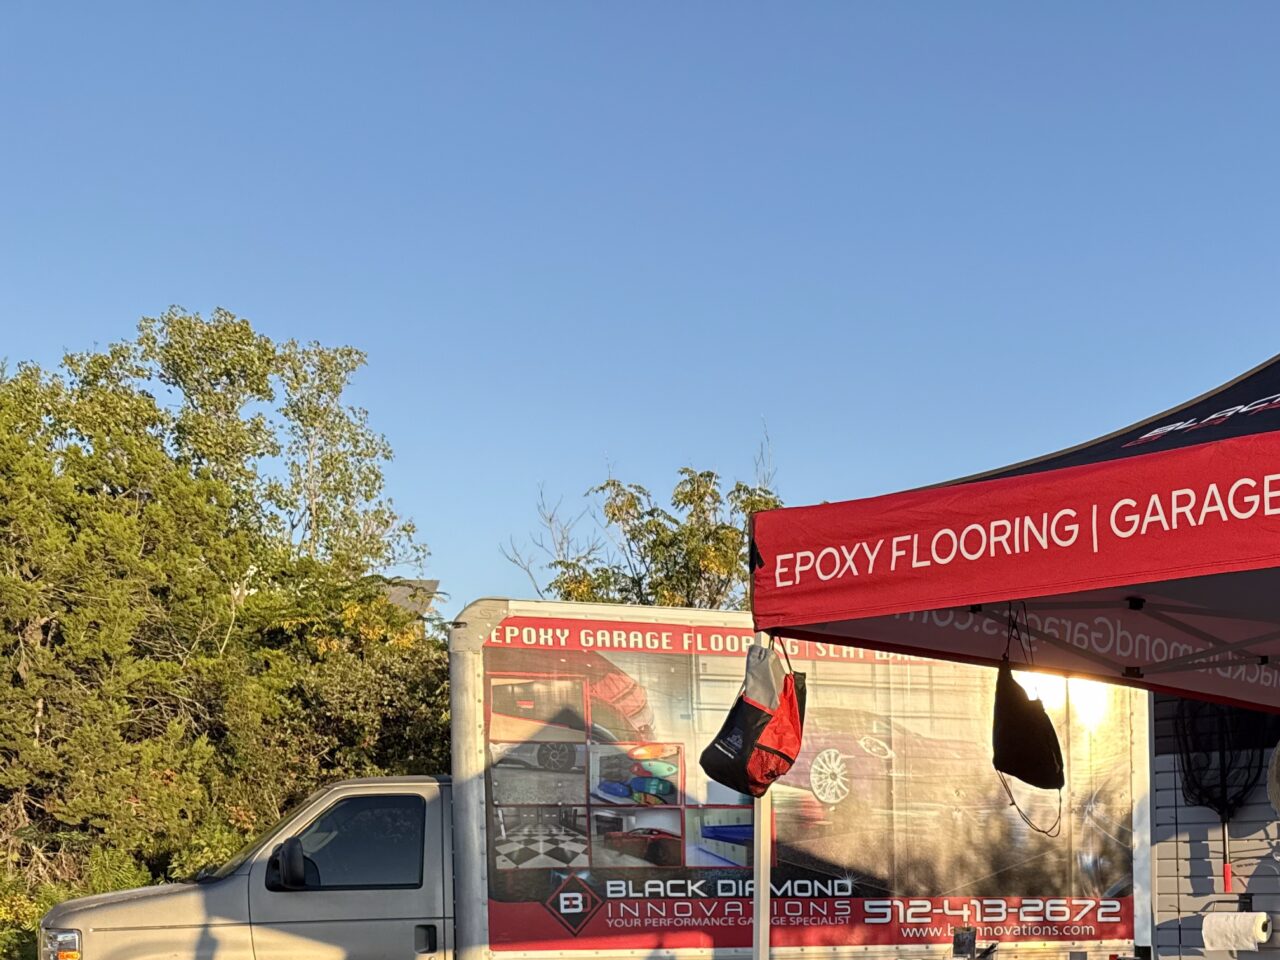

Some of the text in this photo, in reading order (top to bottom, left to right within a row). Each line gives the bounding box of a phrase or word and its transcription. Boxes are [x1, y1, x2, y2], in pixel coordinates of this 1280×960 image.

[775, 539, 884, 589] EPOXY
[890, 508, 1079, 571] FLOORING
[491, 625, 570, 646] EPOXY
[580, 629, 673, 650] GARAGE
[606, 879, 709, 898] BLACK
[607, 901, 851, 917] INNOVAIONS
[863, 898, 1122, 924] 512-413-2672
[606, 916, 851, 928] YOUR PERFORMANCE GAGE SPECIALIST
[901, 922, 1096, 938] www.binnovations.com
